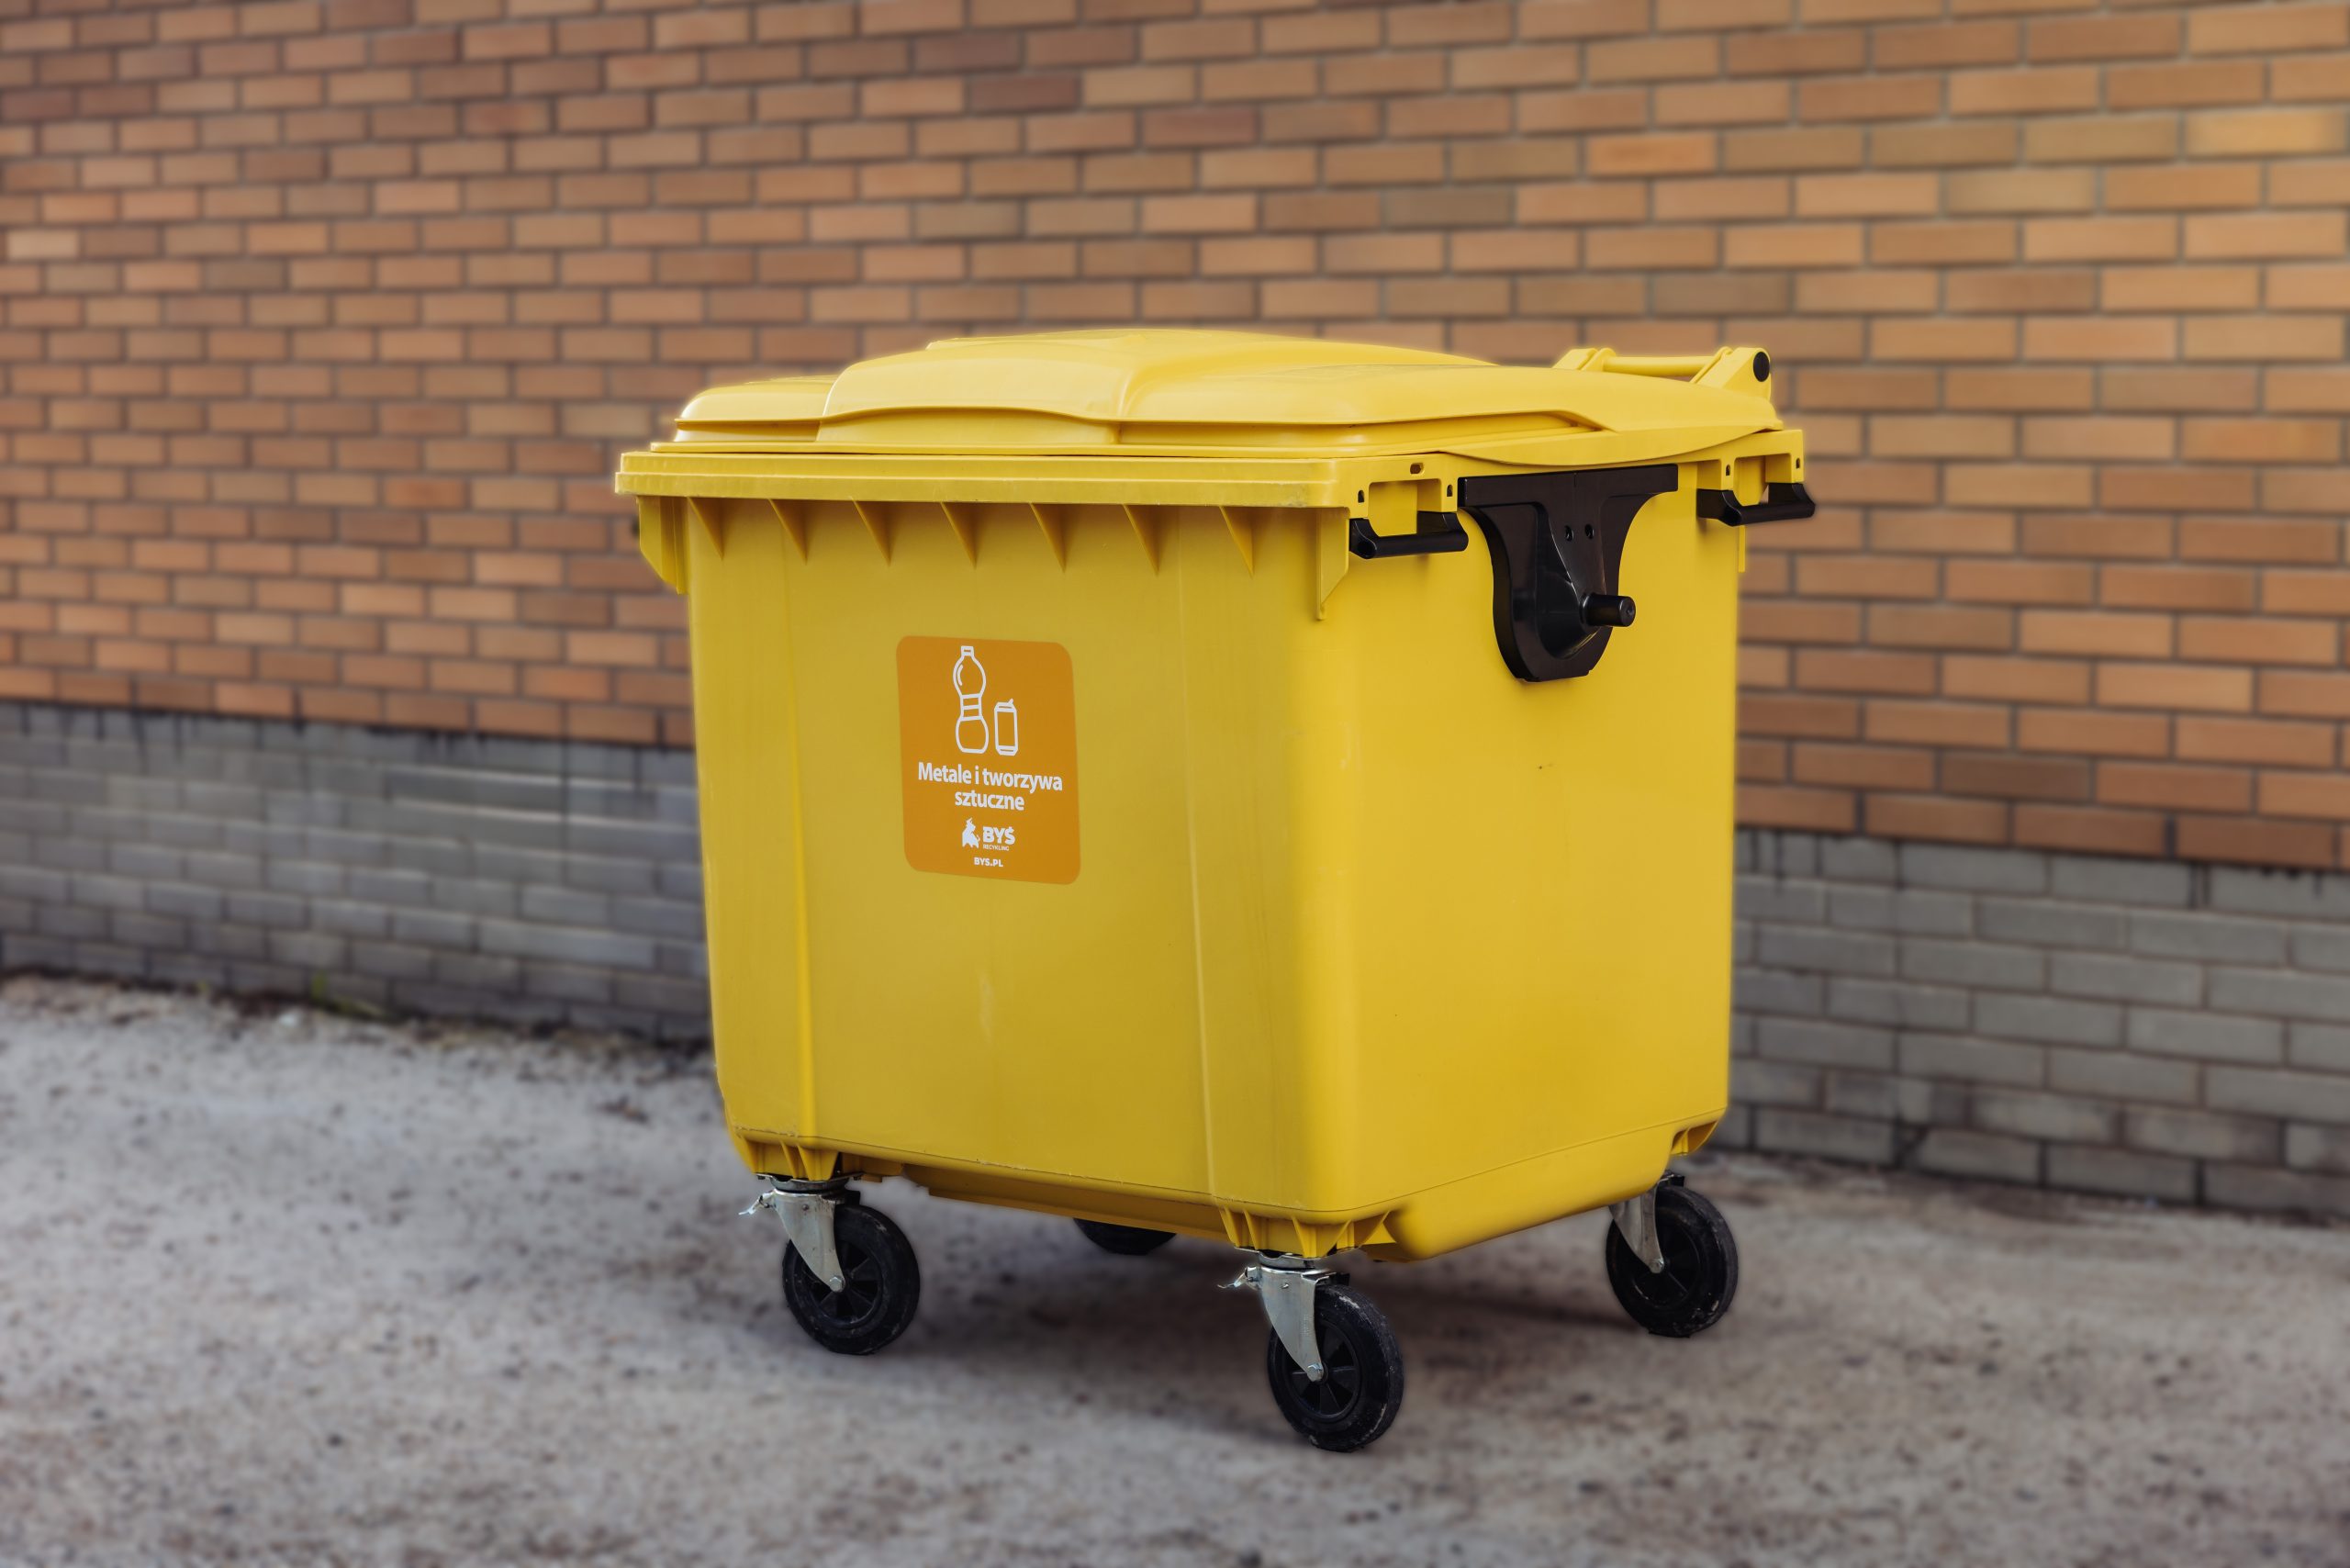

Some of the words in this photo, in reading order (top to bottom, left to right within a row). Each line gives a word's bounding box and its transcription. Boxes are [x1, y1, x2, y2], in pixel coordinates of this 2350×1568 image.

[918, 761, 972, 784] Metale
[975, 766, 979, 785] i
[982, 767, 1063, 794] tworzywa
[955, 790, 1024, 811] sztuczne
[974, 857, 1003, 867] BYS.PL
